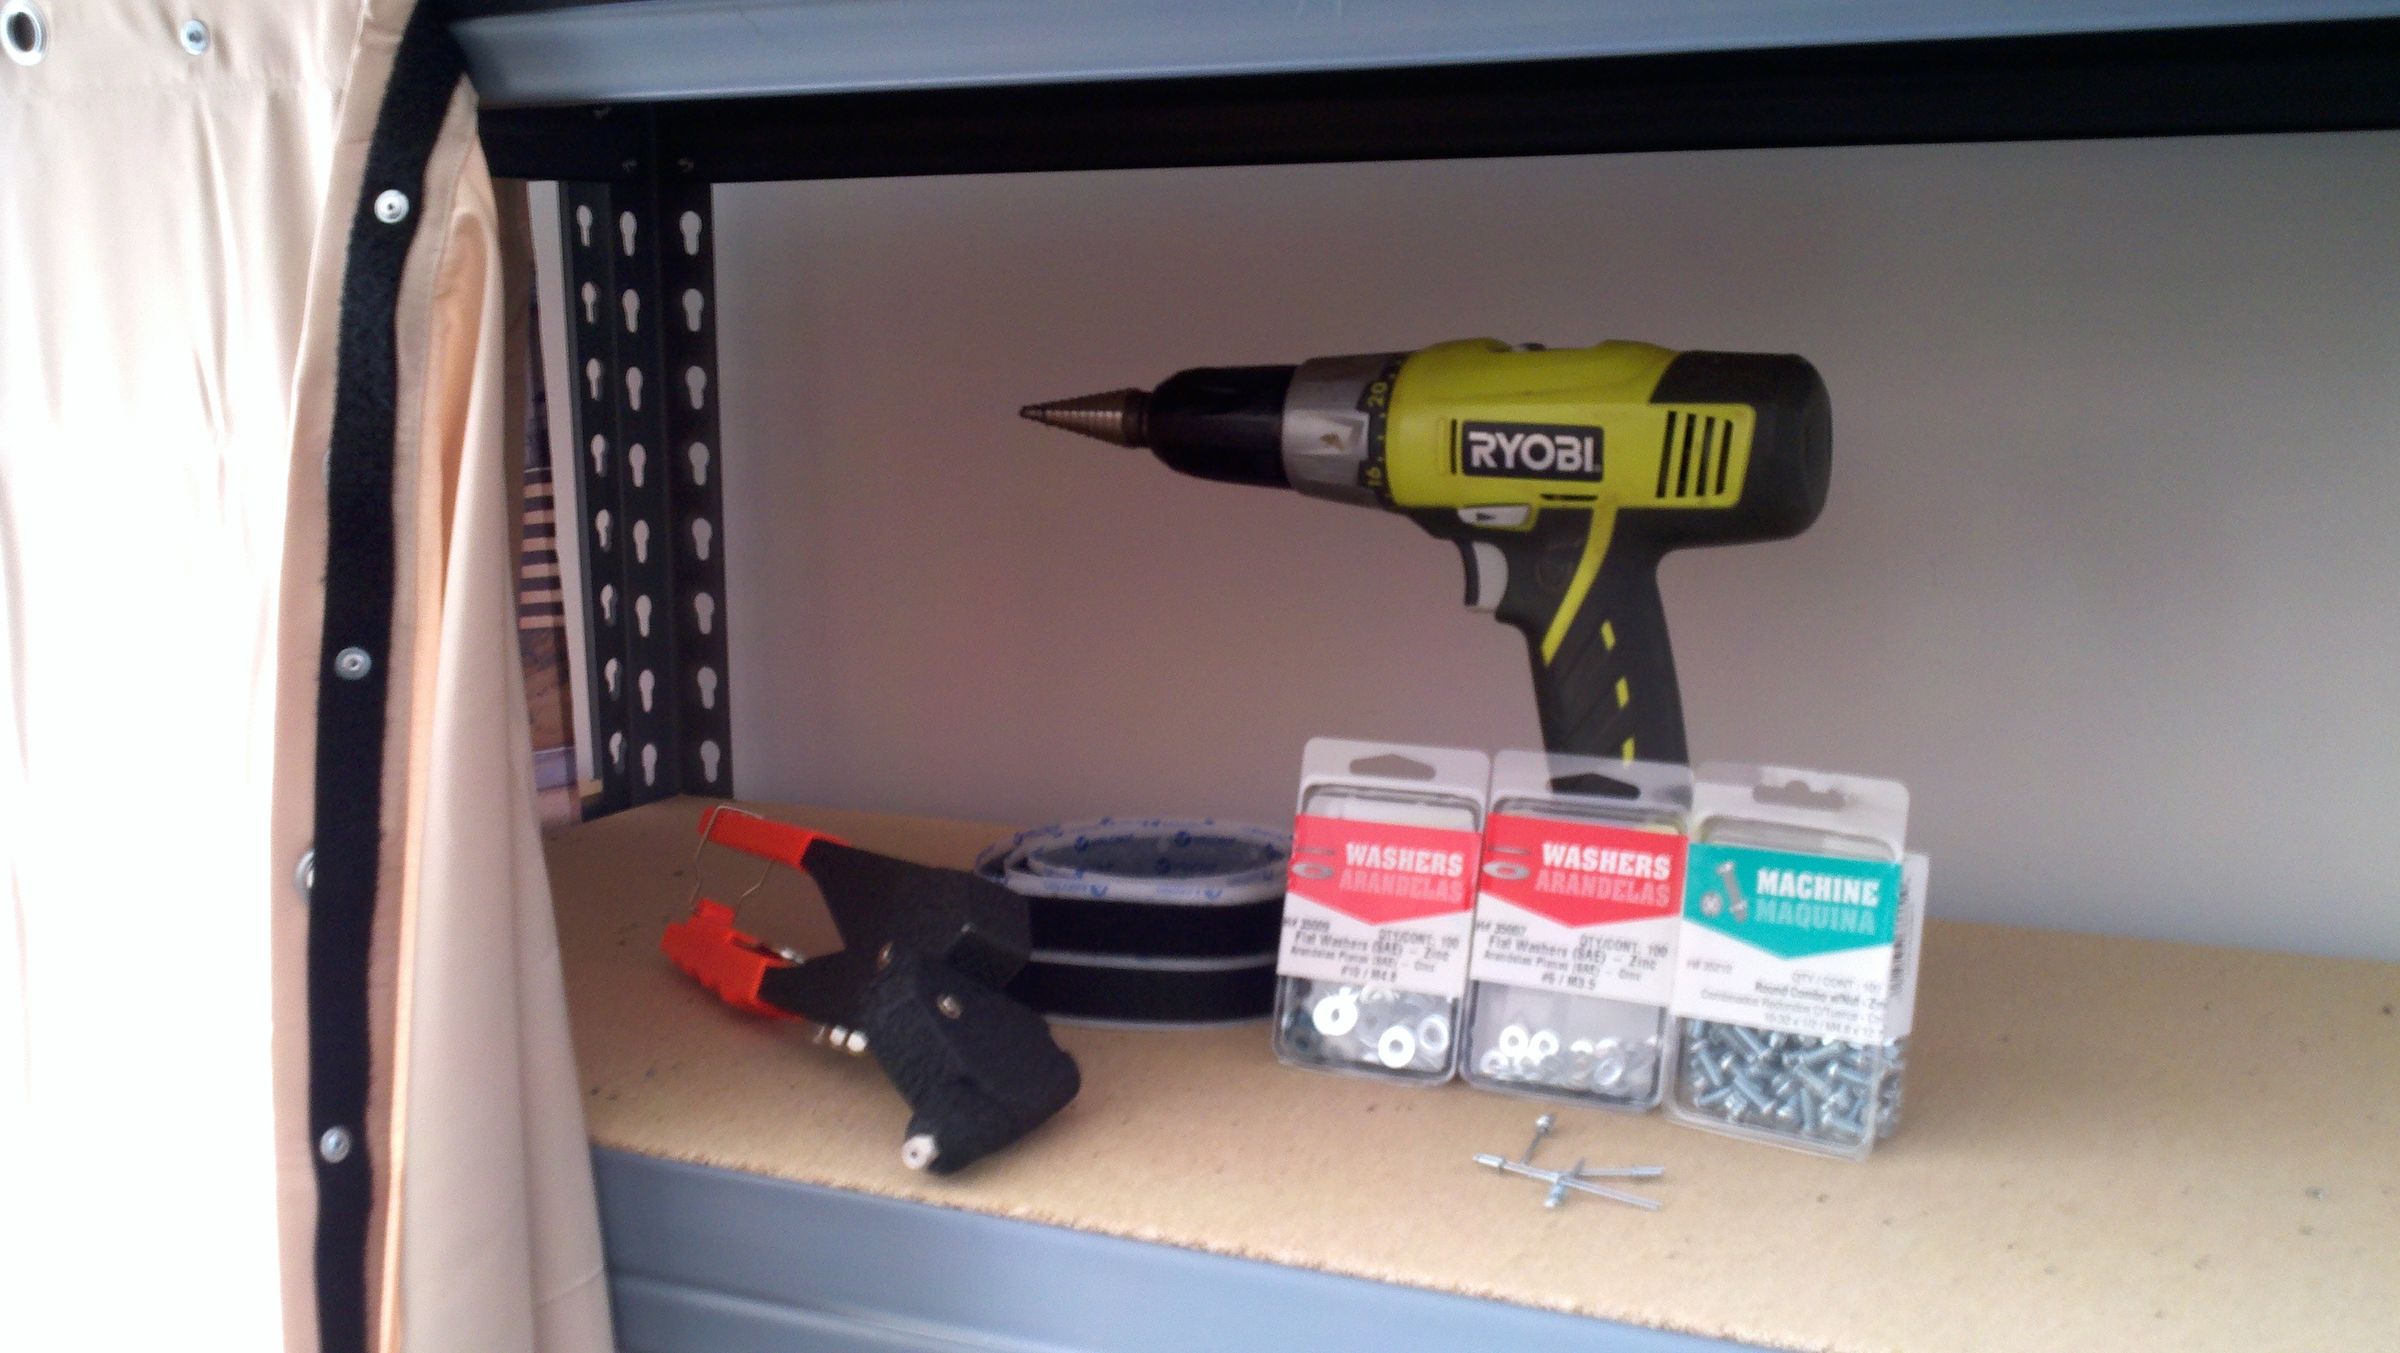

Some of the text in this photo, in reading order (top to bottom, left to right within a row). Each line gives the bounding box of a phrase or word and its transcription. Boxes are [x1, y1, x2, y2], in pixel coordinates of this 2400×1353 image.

[1367, 381, 1388, 407] 20
[1467, 430, 1596, 474] RYOBI
[1365, 465, 1385, 488] 16
[1346, 842, 1464, 878] WASHERS
[1542, 842, 1671, 881] WASHERS
[1338, 866, 1464, 903] ARANDELAS
[1535, 867, 1672, 908] ARANDELAS
[1757, 867, 1880, 908] MACHINE
[1755, 896, 1877, 936] MAQUINA
[1295, 930, 1317, 945] Flat
[1319, 933, 1369, 952] Washers
[1424, 947, 1450, 962] Zinc
[1489, 933, 1513, 950] Flat
[1515, 938, 1569, 959] Washers
[1571, 945, 1607, 966] (SAE)
[1629, 954, 1658, 971] Zinc
